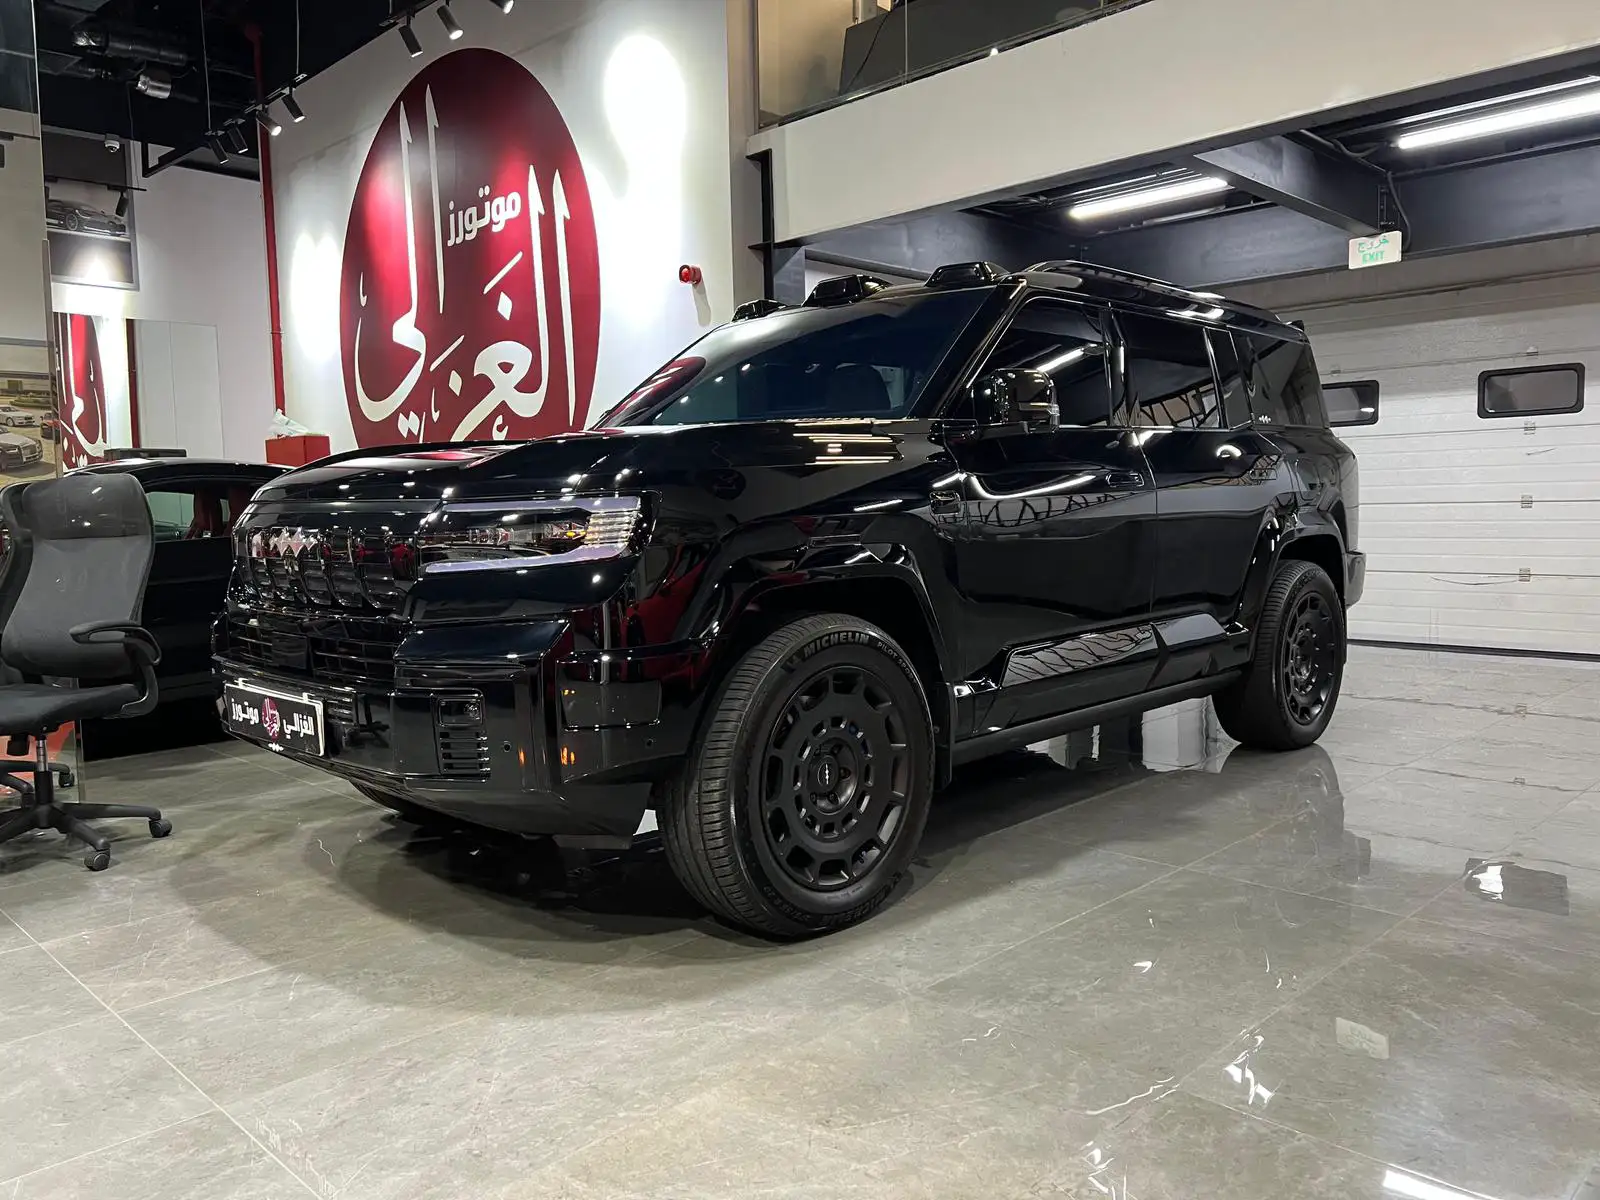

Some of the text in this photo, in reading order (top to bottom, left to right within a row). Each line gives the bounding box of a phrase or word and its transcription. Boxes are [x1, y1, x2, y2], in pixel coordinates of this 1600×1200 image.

[447, 185, 521, 246] موتورز
[1357, 235, 1389, 253] خروج
[1362, 250, 1385, 265] EXIT
[803, 632, 870, 658] MICHELIN
[877, 641, 898, 659] PILOT
[231, 698, 315, 739] الغزالي موتورز
